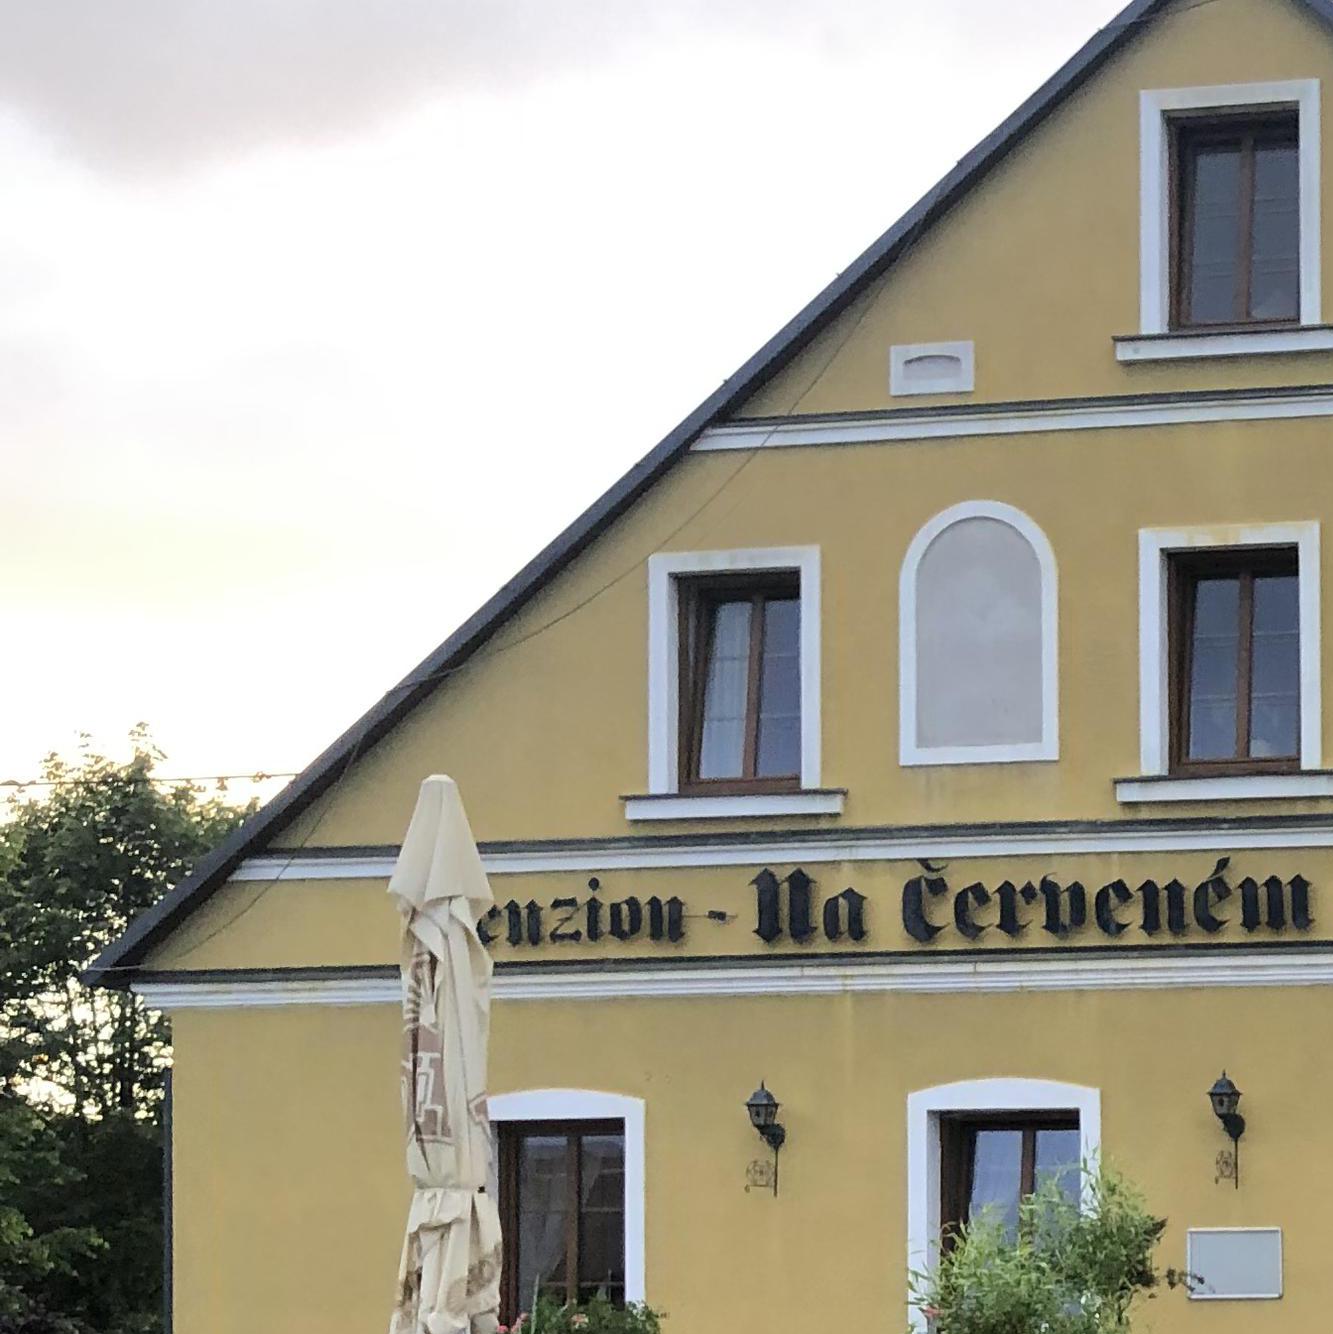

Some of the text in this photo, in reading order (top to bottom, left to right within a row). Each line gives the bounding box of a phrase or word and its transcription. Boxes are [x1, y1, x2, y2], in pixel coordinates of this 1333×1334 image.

[476, 877, 686, 947] enzion
[748, 868, 868, 943] Na
[902, 856, 1315, 943] Červeném
